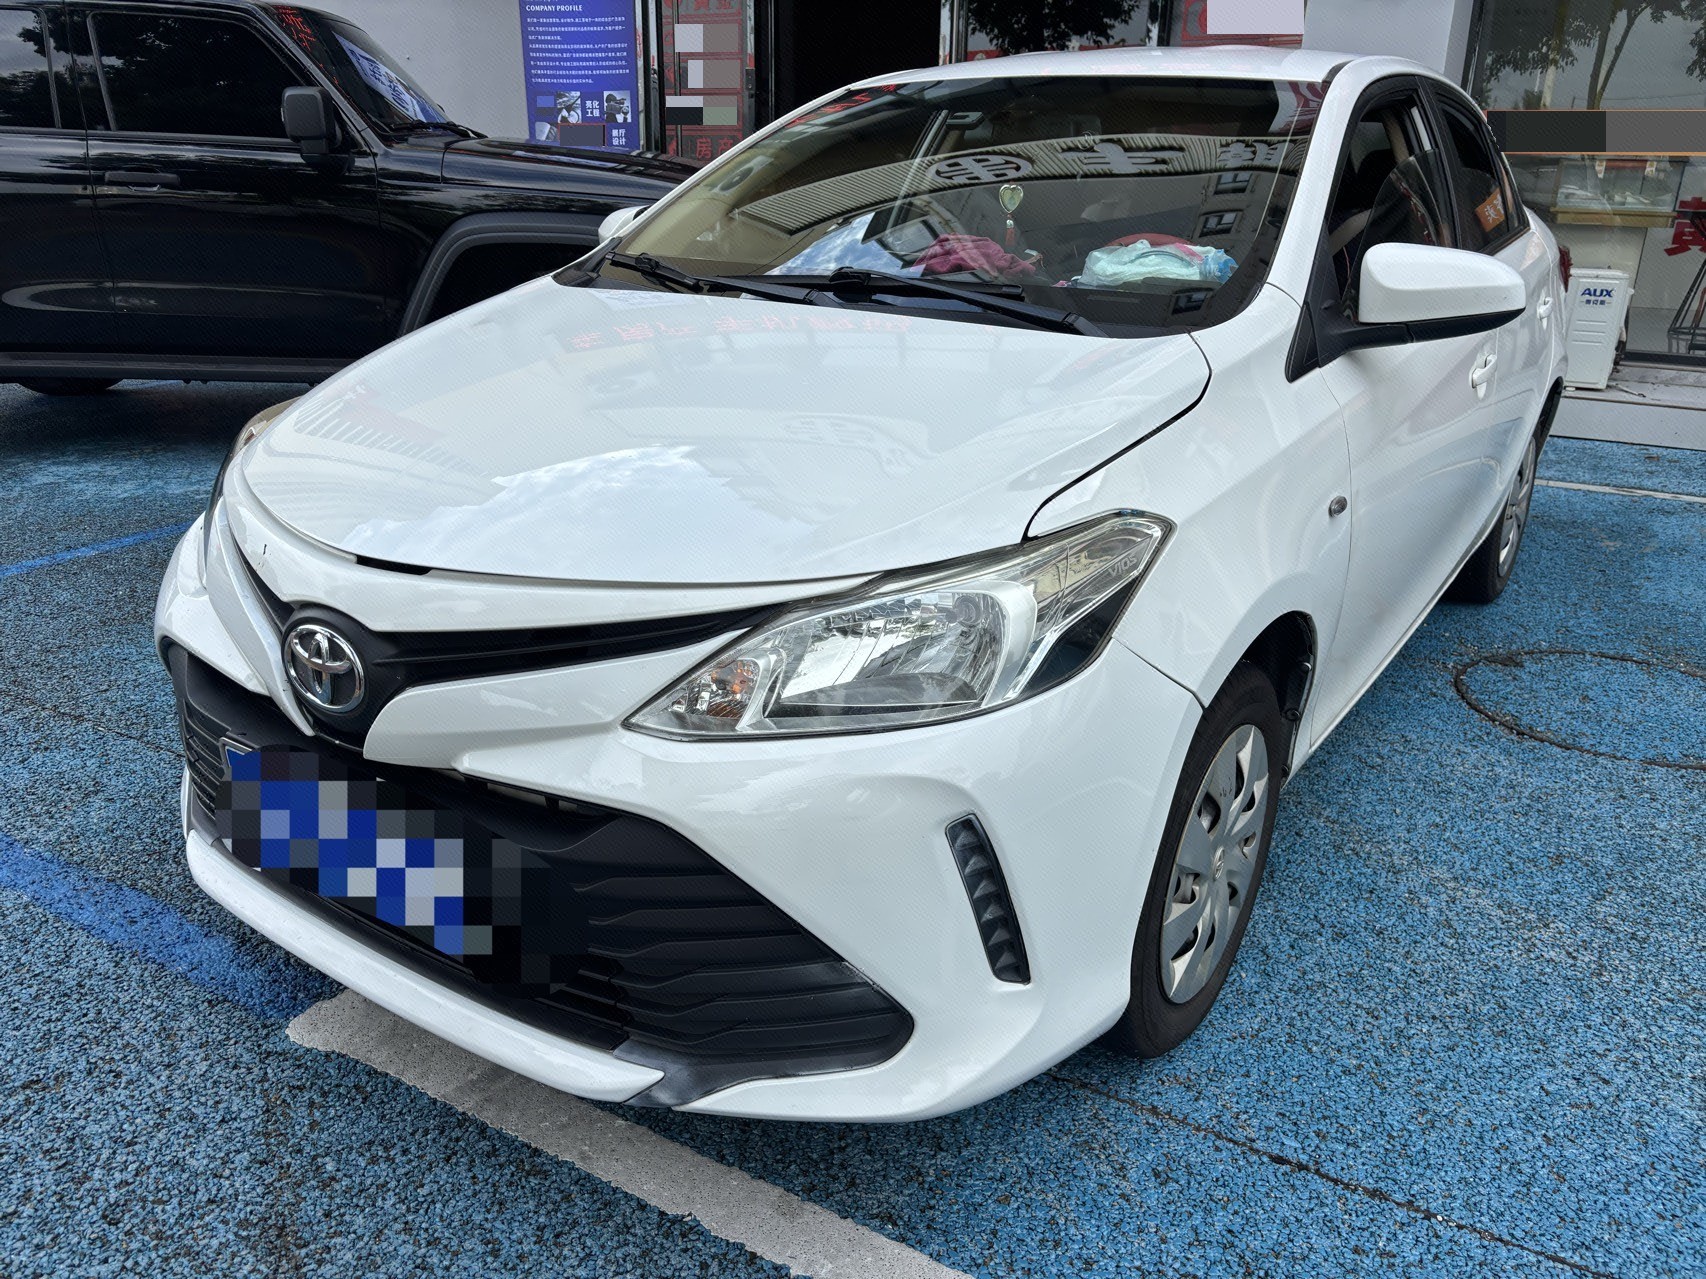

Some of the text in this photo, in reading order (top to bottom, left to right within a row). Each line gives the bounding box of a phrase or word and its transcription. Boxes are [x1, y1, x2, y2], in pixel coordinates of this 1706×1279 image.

[585, 100, 600, 109] 亮化
[585, 109, 600, 117] 工程
[612, 137, 626, 146] 设计
[695, 137, 734, 159] 房产
[1580, 287, 1614, 298] AUX
[1108, 554, 1137, 577] VIOS
